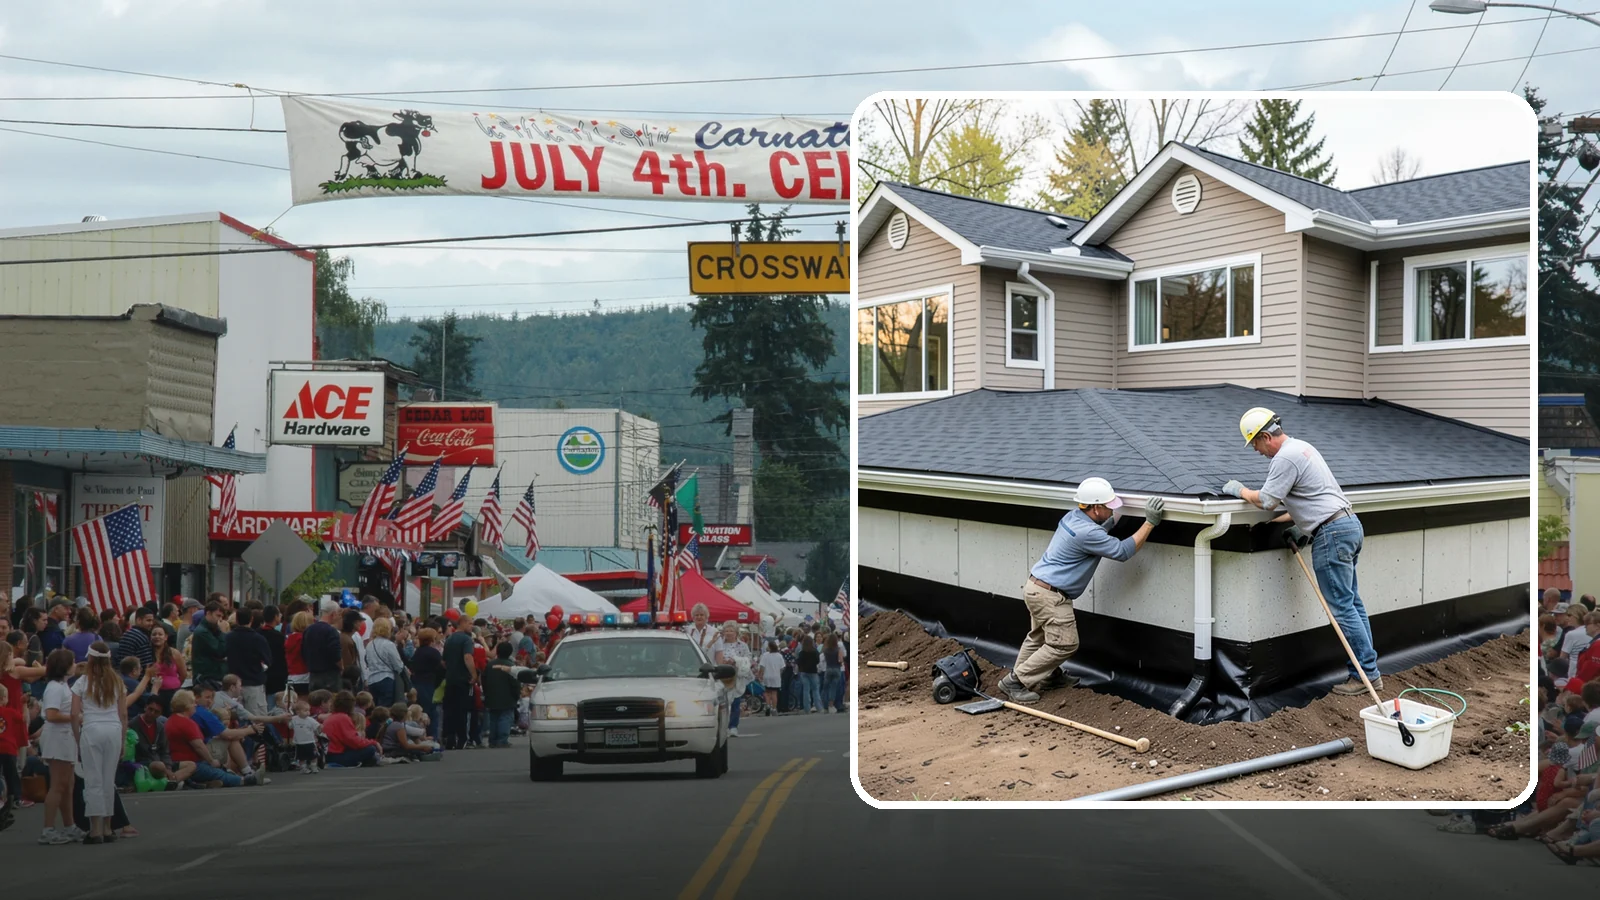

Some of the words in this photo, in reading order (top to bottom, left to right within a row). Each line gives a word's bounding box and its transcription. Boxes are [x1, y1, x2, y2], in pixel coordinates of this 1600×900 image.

[481, 141, 605, 193] JULY
[632, 150, 746, 197] 4th.
[697, 254, 850, 280] CROSSWA
[282, 380, 374, 420] ACE
[405, 409, 452, 421] CEDAR
[461, 409, 485, 421] LOG
[283, 421, 371, 436] Hardware
[416, 428, 477, 446] Coca-Cola
[353, 467, 384, 480] Simpl
[95, 485, 124, 495] Vincent
[126, 486, 135, 495] de
[137, 486, 155, 495] Paul
[688, 526, 741, 535] CRNATION
[699, 535, 730, 543] GLASS
